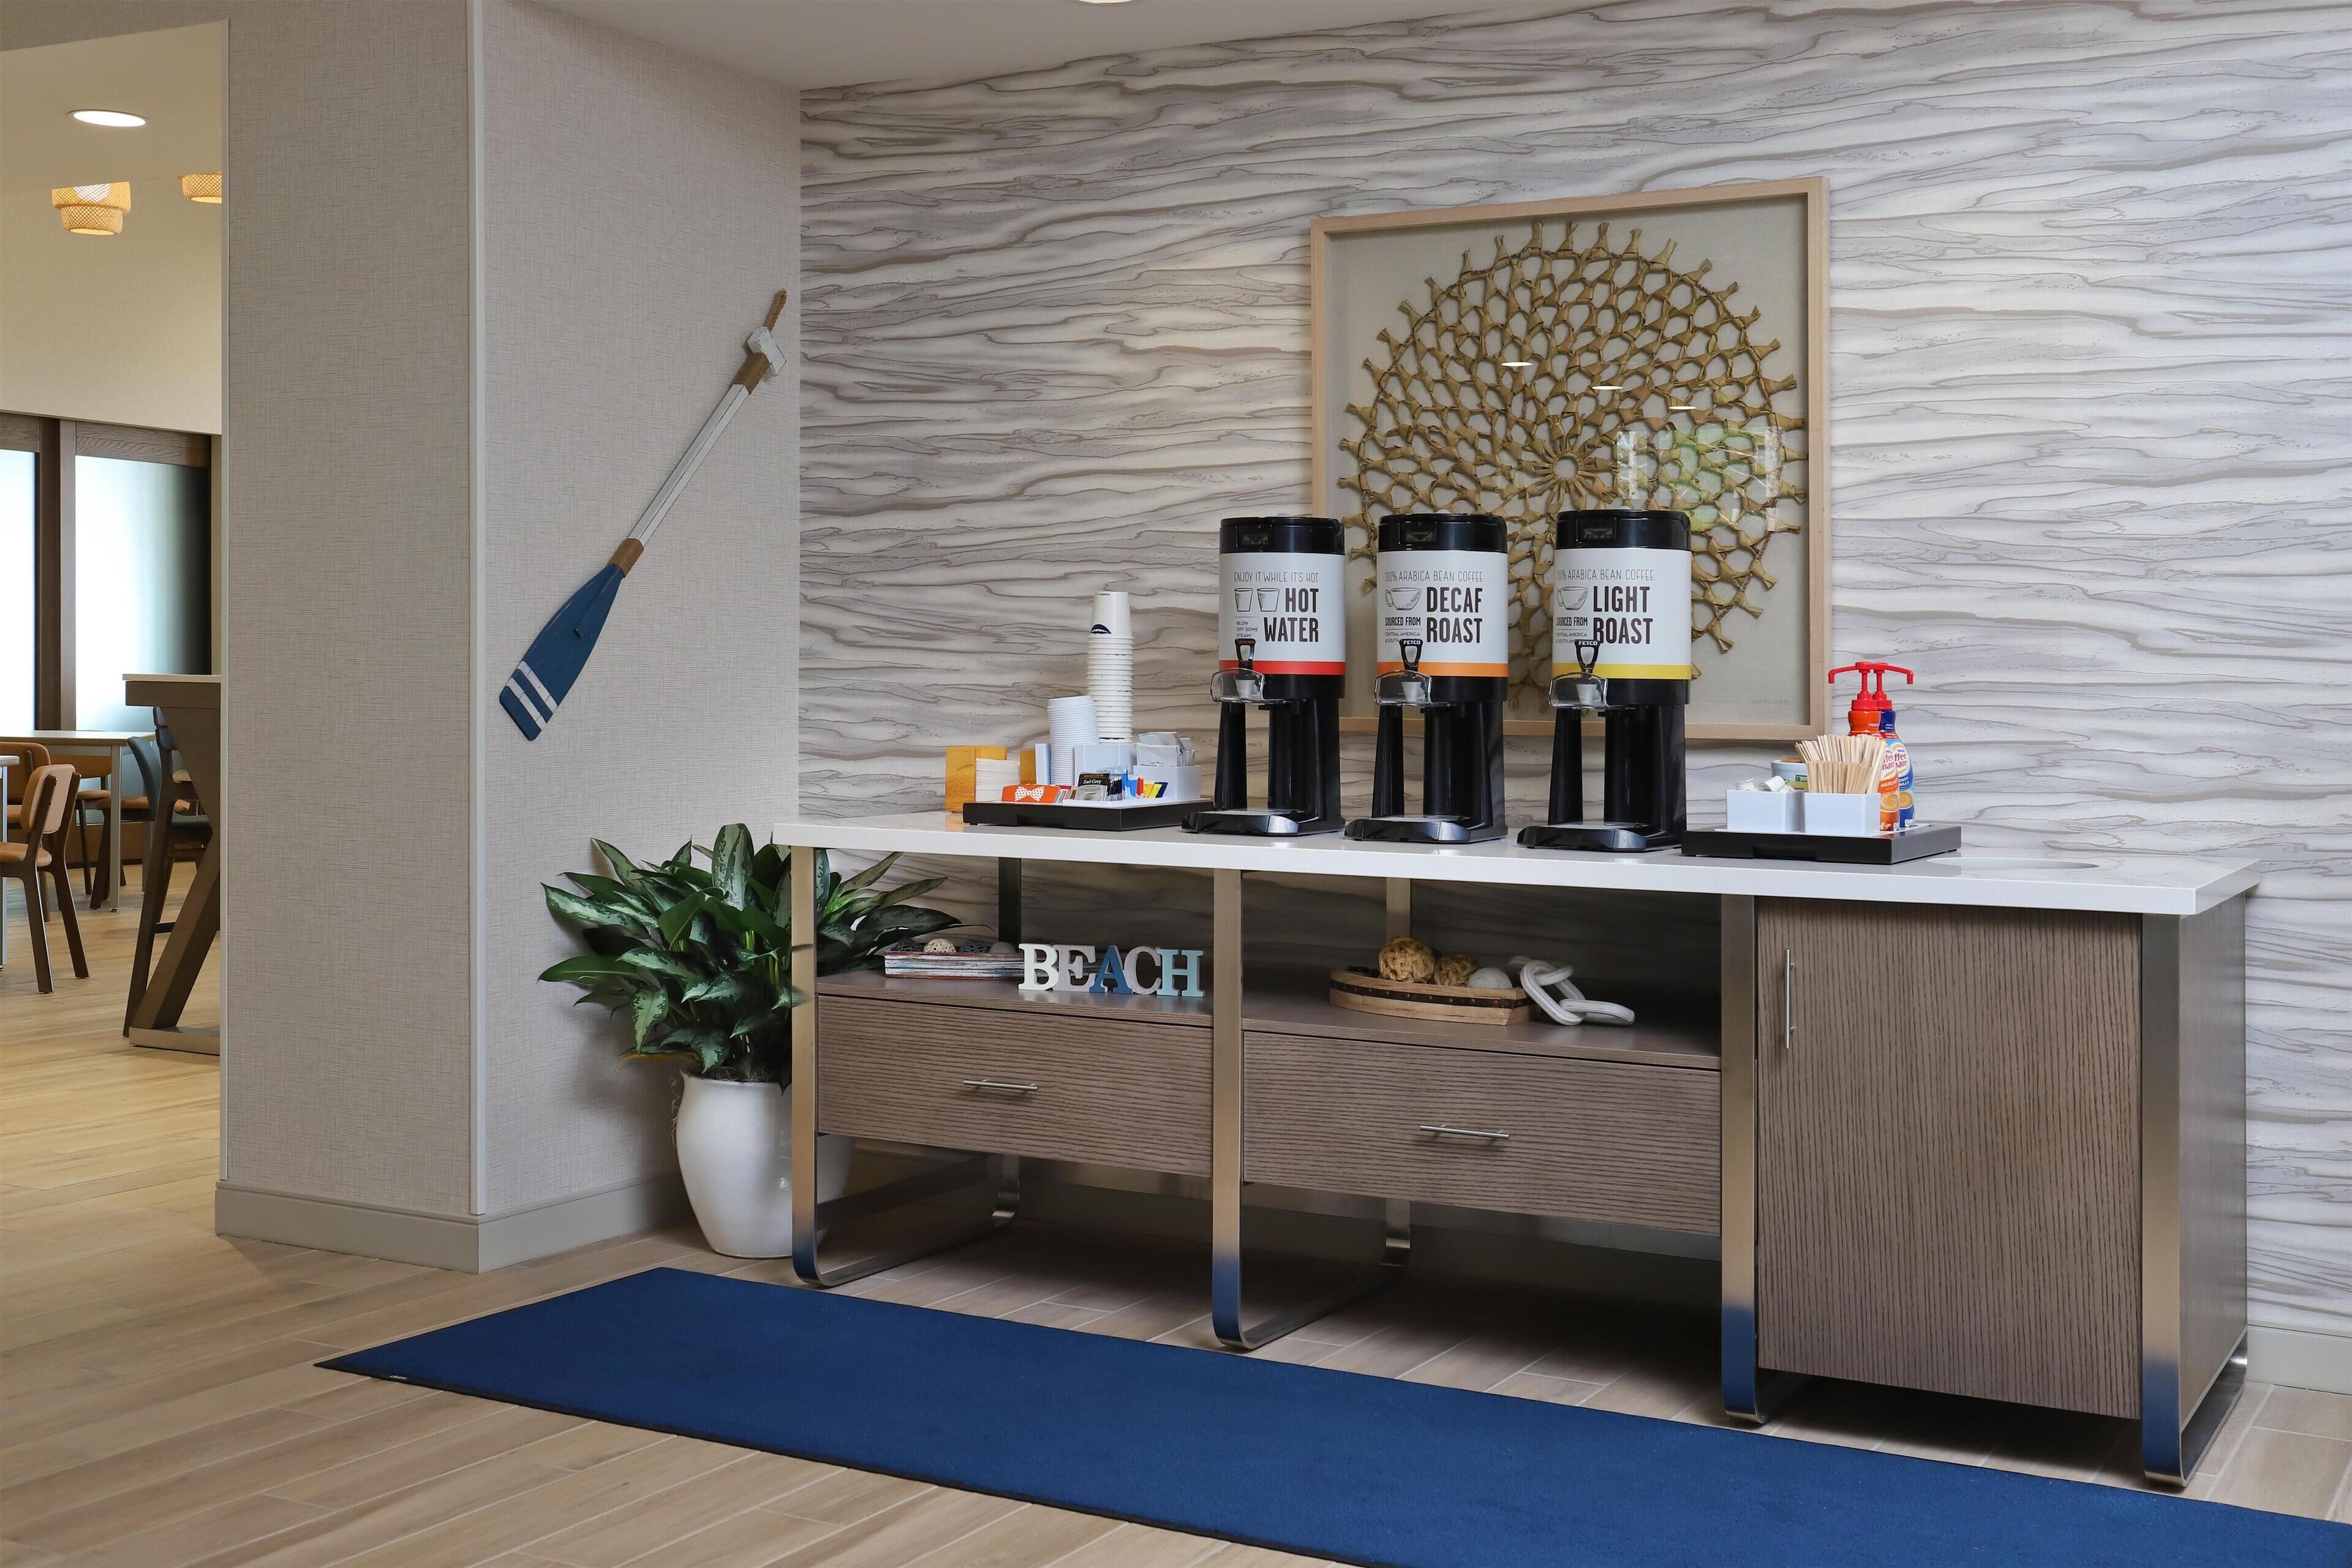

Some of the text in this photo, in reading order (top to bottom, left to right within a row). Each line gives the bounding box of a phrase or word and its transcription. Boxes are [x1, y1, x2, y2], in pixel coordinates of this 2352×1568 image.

[1234, 571, 1319, 582] ENJOY IT WHILE IT'S HOT
[1385, 571, 1483, 582] 100% ARABICA BEAN COFFEE
[1568, 569, 1597, 580] ARABICA
[1600, 569, 1621, 580] BEAN
[1625, 569, 1654, 581] COFFEE
[1286, 588, 1319, 613] HOT
[1427, 587, 1483, 612] DECAF
[1593, 586, 1650, 612] LIGHT
[1264, 617, 1319, 642] WATER
[1385, 617, 1421, 626] SOURCED FROM
[1427, 617, 1483, 643] ROAST
[1556, 617, 1588, 627] SOURCED FROM
[1593, 617, 1653, 644] ROAST
[1894, 753, 1907, 761] ffee
[1017, 943, 1206, 998] BEACH
